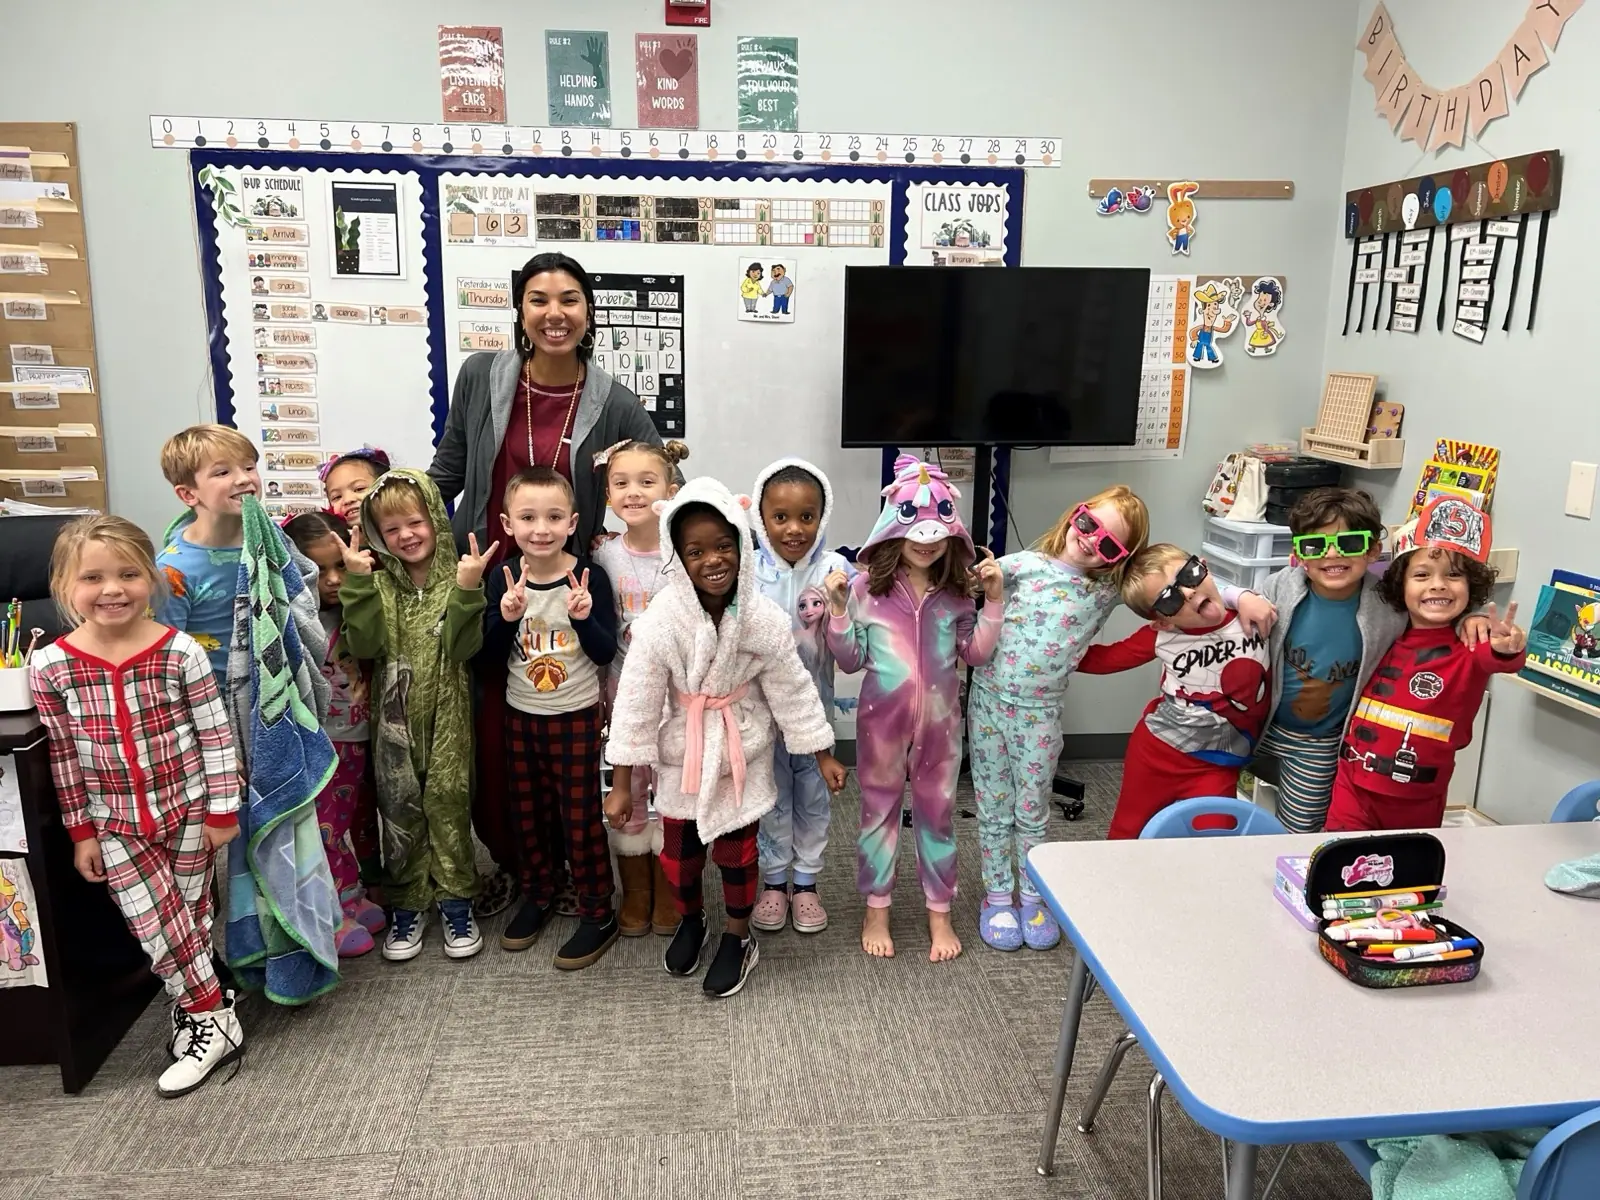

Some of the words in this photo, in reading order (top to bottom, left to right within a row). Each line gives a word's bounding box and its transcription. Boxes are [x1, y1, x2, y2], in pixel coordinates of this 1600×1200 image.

[549, 37, 561, 45] RULE
[559, 75, 598, 88] HELPING
[657, 77, 679, 91] KIND
[462, 91, 486, 106] EARS
[564, 94, 594, 108] HANDS
[651, 97, 685, 110] WORDS
[757, 99, 779, 112] BEST
[163, 119, 173, 133] 0
[227, 121, 235, 136] 2
[258, 121, 267, 136] 3
[288, 122, 297, 136] 4
[320, 123, 330, 137] 5
[351, 125, 361, 139] 6
[382, 126, 390, 140] 7
[413, 127, 422, 142] 8
[444, 127, 451, 141] 9
[471, 128, 482, 142] 10
[505, 130, 511, 143] 11
[533, 130, 542, 144] 12
[562, 130, 572, 144] 13
[592, 131, 601, 145] 14
[621, 132, 632, 146] 15
[649, 133, 659, 147] 16
[679, 133, 689, 147] 17
[707, 135, 719, 149] 18
[738, 134, 746, 149] 19
[763, 135, 777, 149] 20
[794, 135, 803, 149] 21
[819, 135, 832, 149] 22
[848, 136, 862, 150] 23
[876, 137, 889, 150] 24
[903, 138, 918, 151] 25
[932, 139, 946, 152] 26
[959, 139, 973, 152] 27
[988, 140, 1001, 153] 28
[1015, 140, 1027, 153] 29
[1040, 141, 1056, 154] 30
[243, 177, 260, 189] OUR
[265, 178, 301, 191] SCHEDULE
[492, 187, 514, 200] BEEN
[518, 187, 529, 200] AT
[1474, 182, 1482, 216] September
[582, 195, 591, 206] 10
[640, 196, 653, 208] 30
[698, 198, 712, 209] 50
[815, 200, 826, 211] 90
[924, 193, 961, 212] CLASS
[968, 194, 1001, 213] JOBS
[486, 215, 499, 232] 6
[507, 215, 521, 234] 3
[582, 219, 593, 230] 20
[641, 220, 653, 231] 40
[699, 222, 712, 233] 60
[757, 224, 770, 235] 80
[814, 224, 828, 235] 100
[272, 229, 296, 239] Arrival
[278, 281, 295, 290] snack
[458, 279, 492, 290] Yesterday
[494, 282, 508, 290] was
[468, 291, 508, 306] Thursday
[594, 292, 622, 305] mber
[650, 292, 676, 306] 2022
[336, 309, 358, 318] science
[399, 312, 409, 320] art
[610, 312, 632, 322] Thursday
[636, 313, 652, 322] Friday
[471, 323, 492, 333] Today
[494, 323, 500, 332] is
[1152, 319, 1160, 327] 28
[1165, 319, 1172, 327] 29
[478, 338, 504, 349] Friday
[598, 332, 605, 347] 2
[620, 331, 630, 346] 3
[644, 332, 652, 347] 4
[664, 332, 674, 348] 5
[619, 353, 631, 369] 10
[665, 354, 675, 369] 12
[642, 375, 655, 391] 18
[288, 407, 307, 416] lunch
[288, 432, 308, 440] math
[288, 456, 314, 466] phonics
